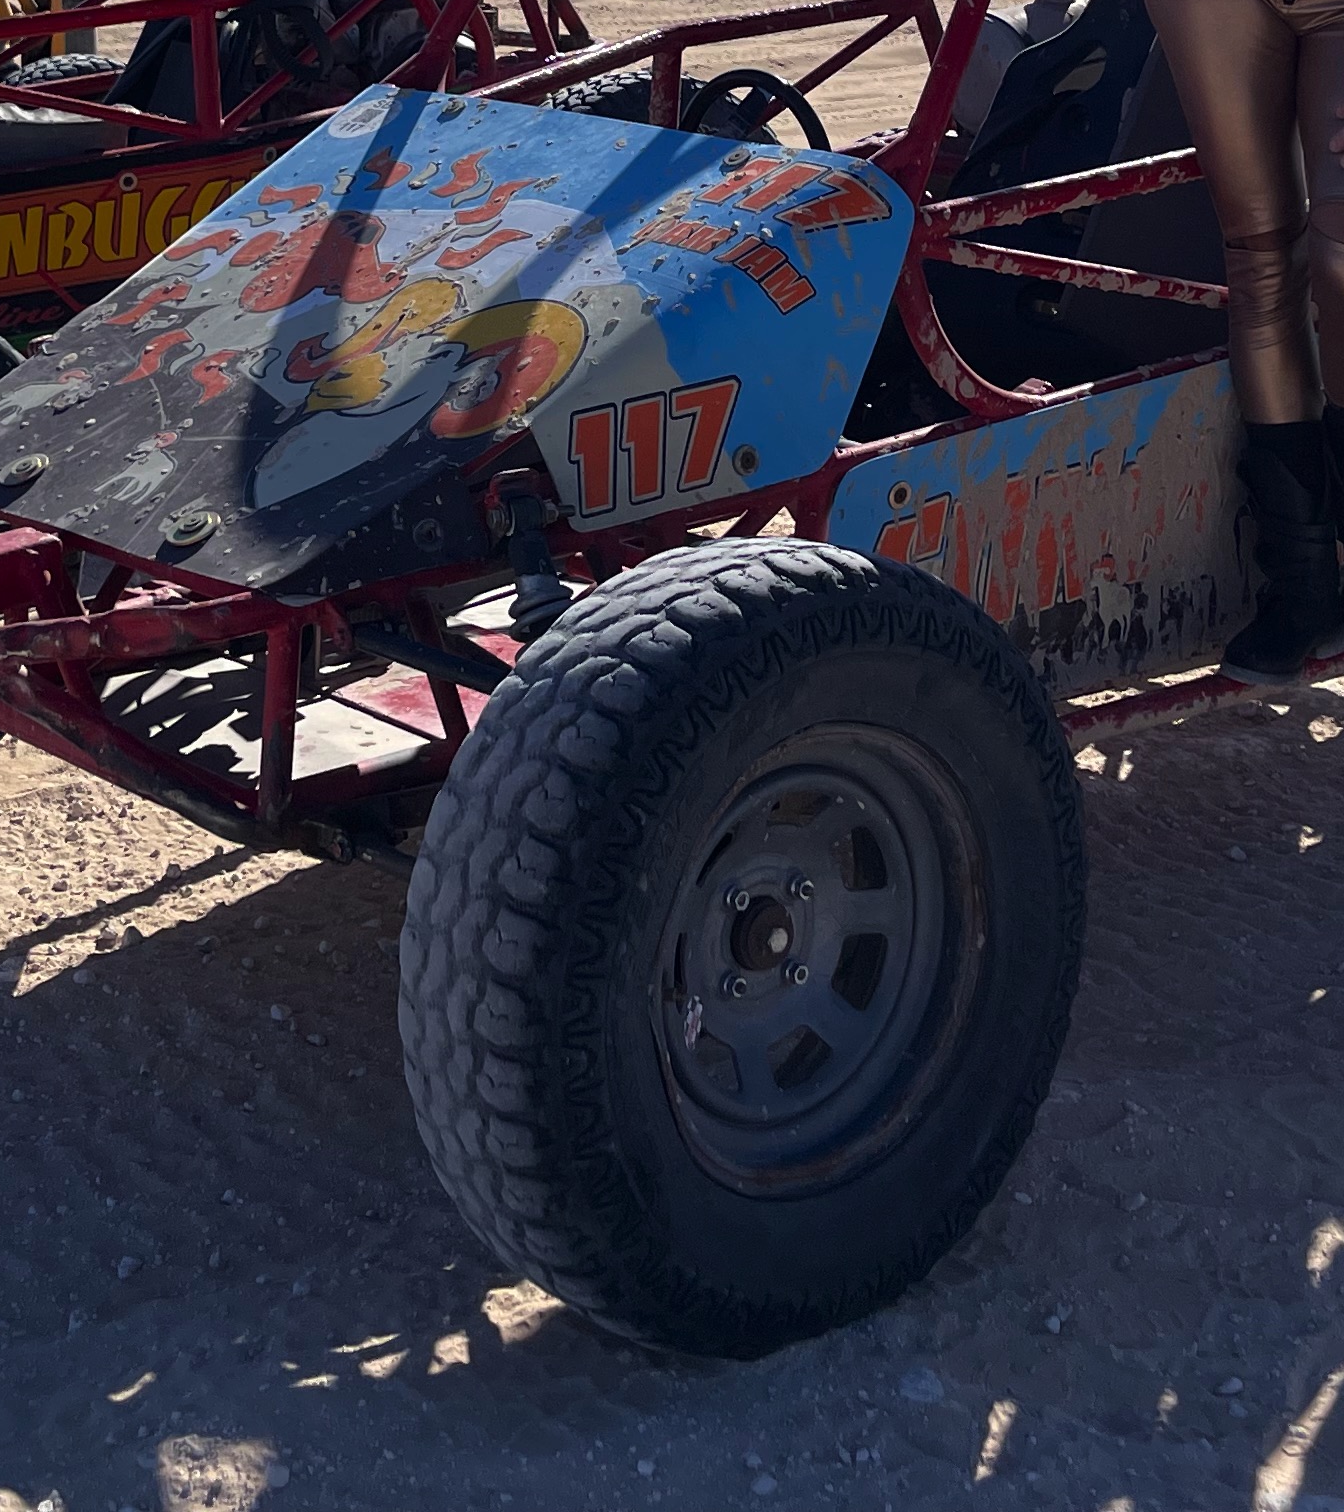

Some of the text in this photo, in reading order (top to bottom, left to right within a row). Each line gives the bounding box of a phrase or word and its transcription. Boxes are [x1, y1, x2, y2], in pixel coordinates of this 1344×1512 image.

[694, 155, 893, 234] 117
[712, 234, 816, 316] JAM
[567, 374, 742, 519] 117
